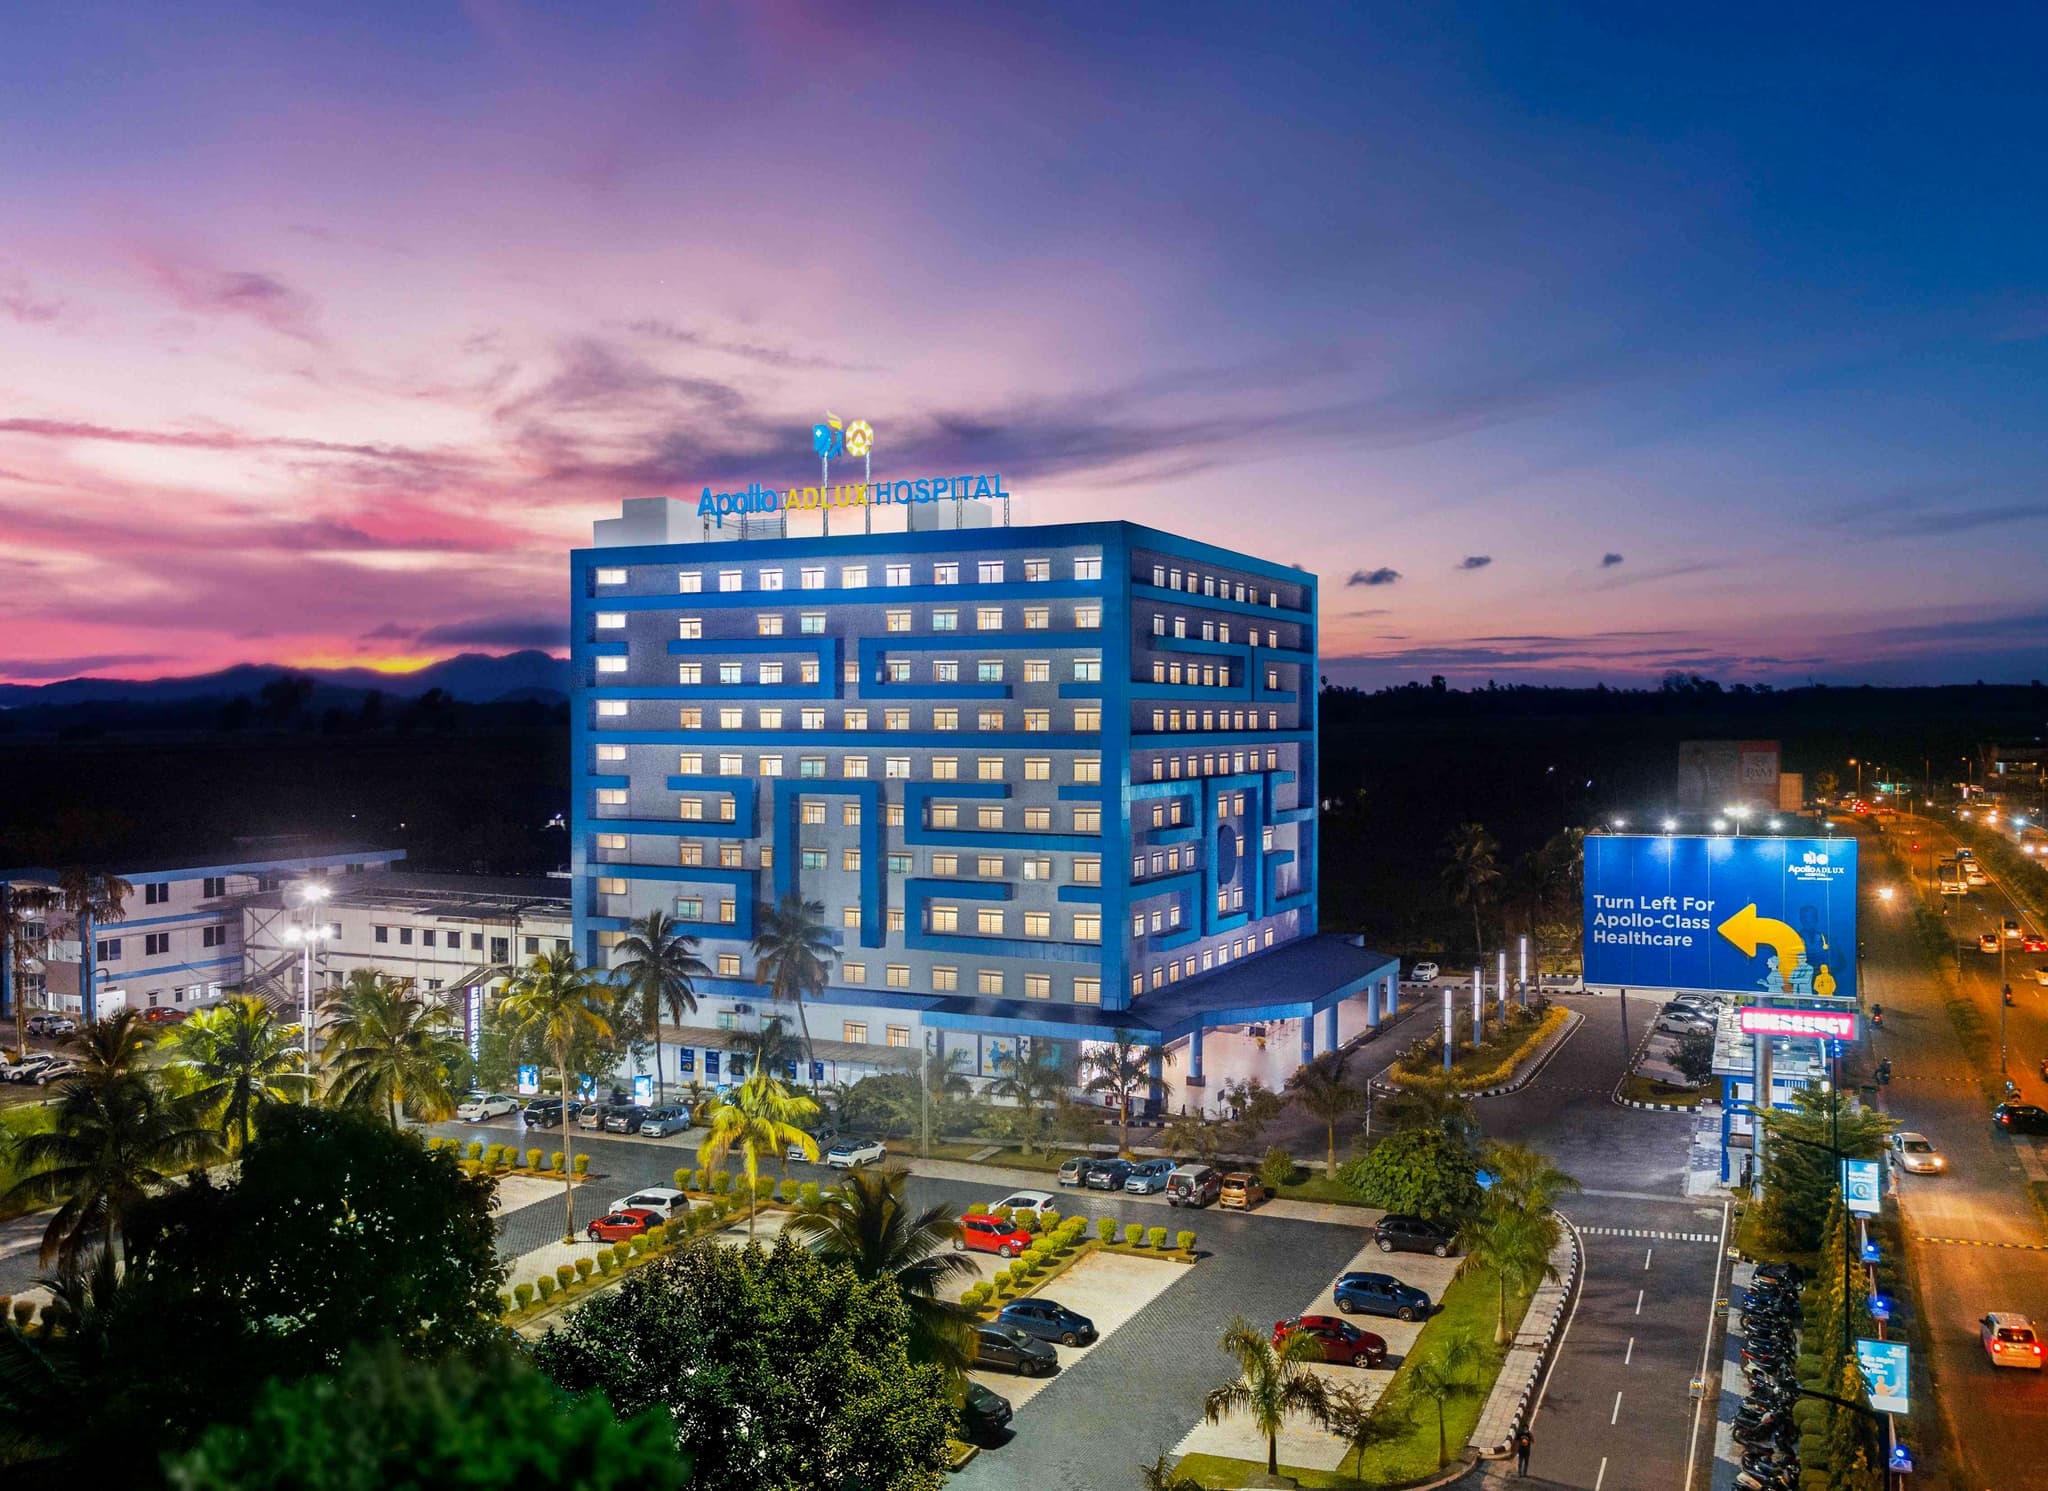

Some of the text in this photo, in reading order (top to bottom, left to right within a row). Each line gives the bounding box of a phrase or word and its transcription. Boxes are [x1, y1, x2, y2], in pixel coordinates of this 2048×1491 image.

[697, 473, 1009, 528] Apollo ADLUX HOSPITAL
[1593, 895, 1715, 912] Turn Left For
[1593, 912, 1710, 929] Apollo-Class
[1594, 930, 1693, 946] Healthcare
